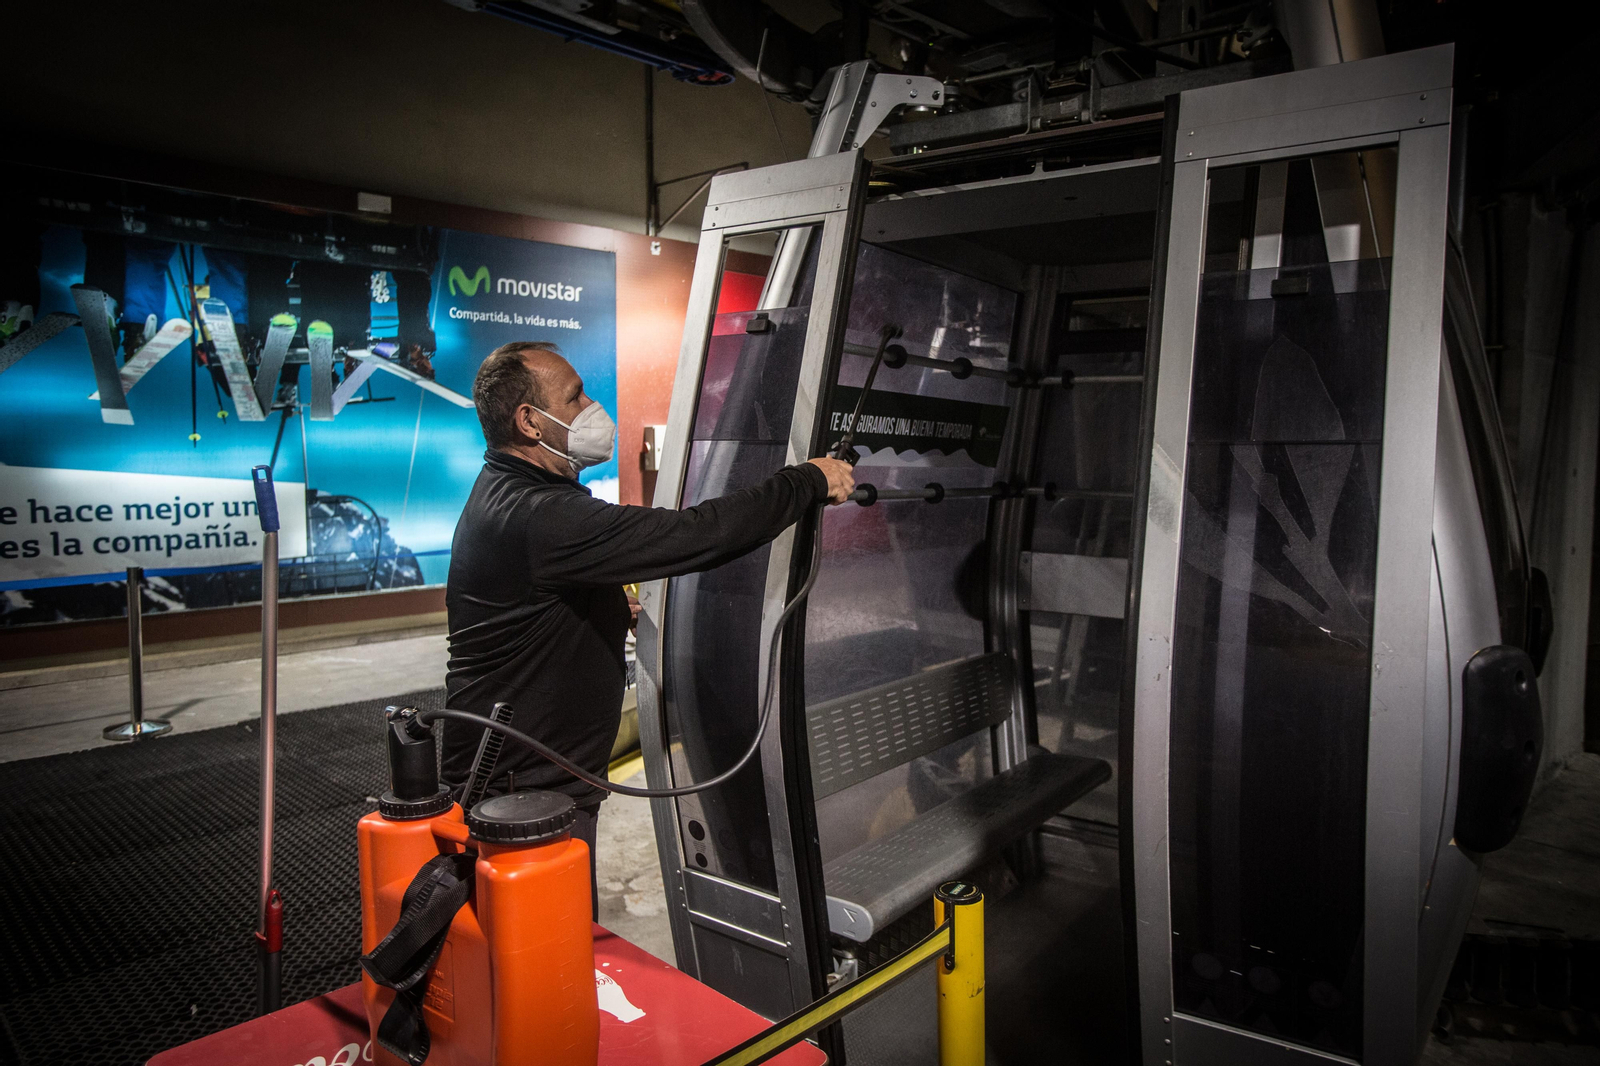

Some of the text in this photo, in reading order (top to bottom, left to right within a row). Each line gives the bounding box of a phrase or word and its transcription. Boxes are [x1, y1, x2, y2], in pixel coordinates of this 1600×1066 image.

[497, 277, 583, 303] movistar
[449, 306, 583, 330] Compartida, la vida es más.
[829, 411, 973, 441] TE ASGURAMOS UNA BUENA TEMPORADA
[27, 498, 113, 524] hace
[123, 496, 214, 526] mejor
[0, 523, 257, 559] es la compañía.
